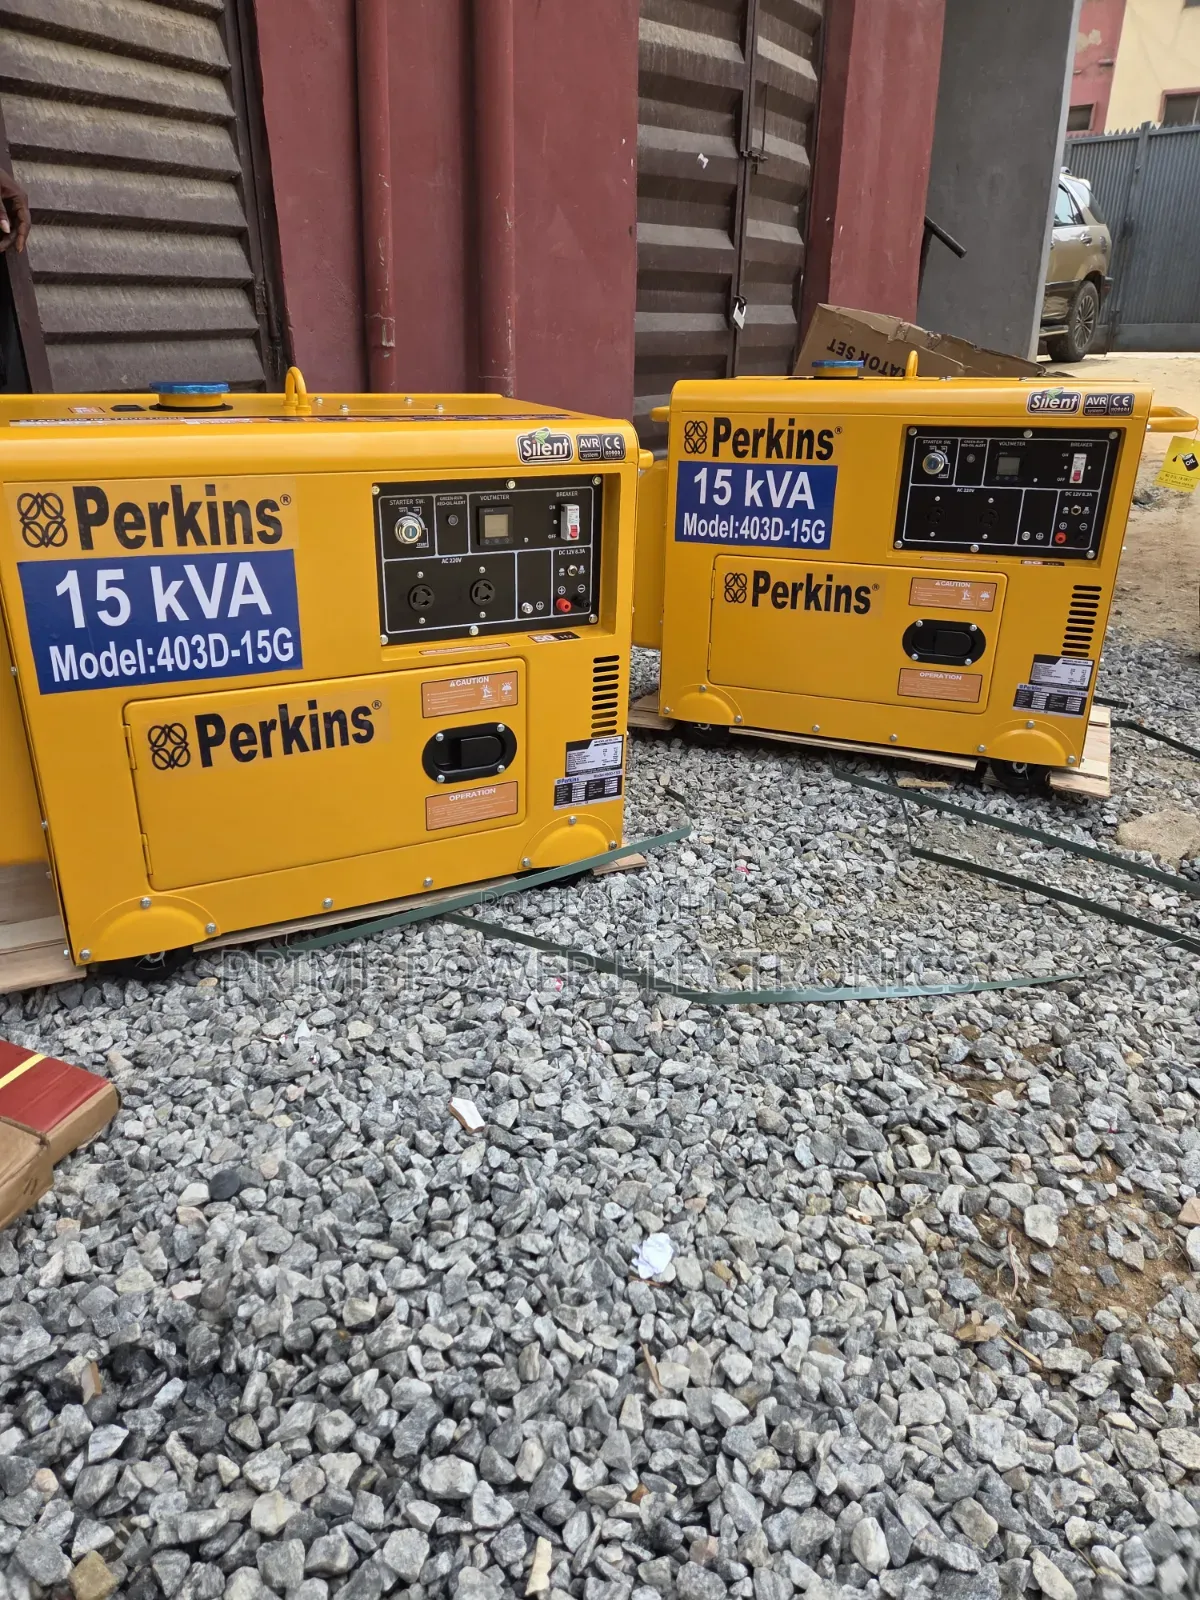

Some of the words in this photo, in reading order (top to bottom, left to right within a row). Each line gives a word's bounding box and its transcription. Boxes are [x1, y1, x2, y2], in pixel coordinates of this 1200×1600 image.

[827, 339, 856, 360] SET
[1031, 395, 1077, 409] Silent
[1086, 396, 1107, 405] AVR
[523, 438, 569, 457] Silent
[580, 438, 600, 449] AVR
[1185, 458, 1196, 466] OIL
[693, 467, 733, 506] 15
[744, 469, 816, 510] kVA
[683, 512, 826, 544] Model:403D-15G
[940, 580, 971, 588] CAUTION
[55, 568, 131, 629] 15
[150, 561, 273, 623] kVA
[49, 626, 295, 683] Model:403D-15G
[456, 676, 490, 687] CAUTION
[919, 671, 962, 681] OPERATION
[449, 787, 497, 802] OPERATION
